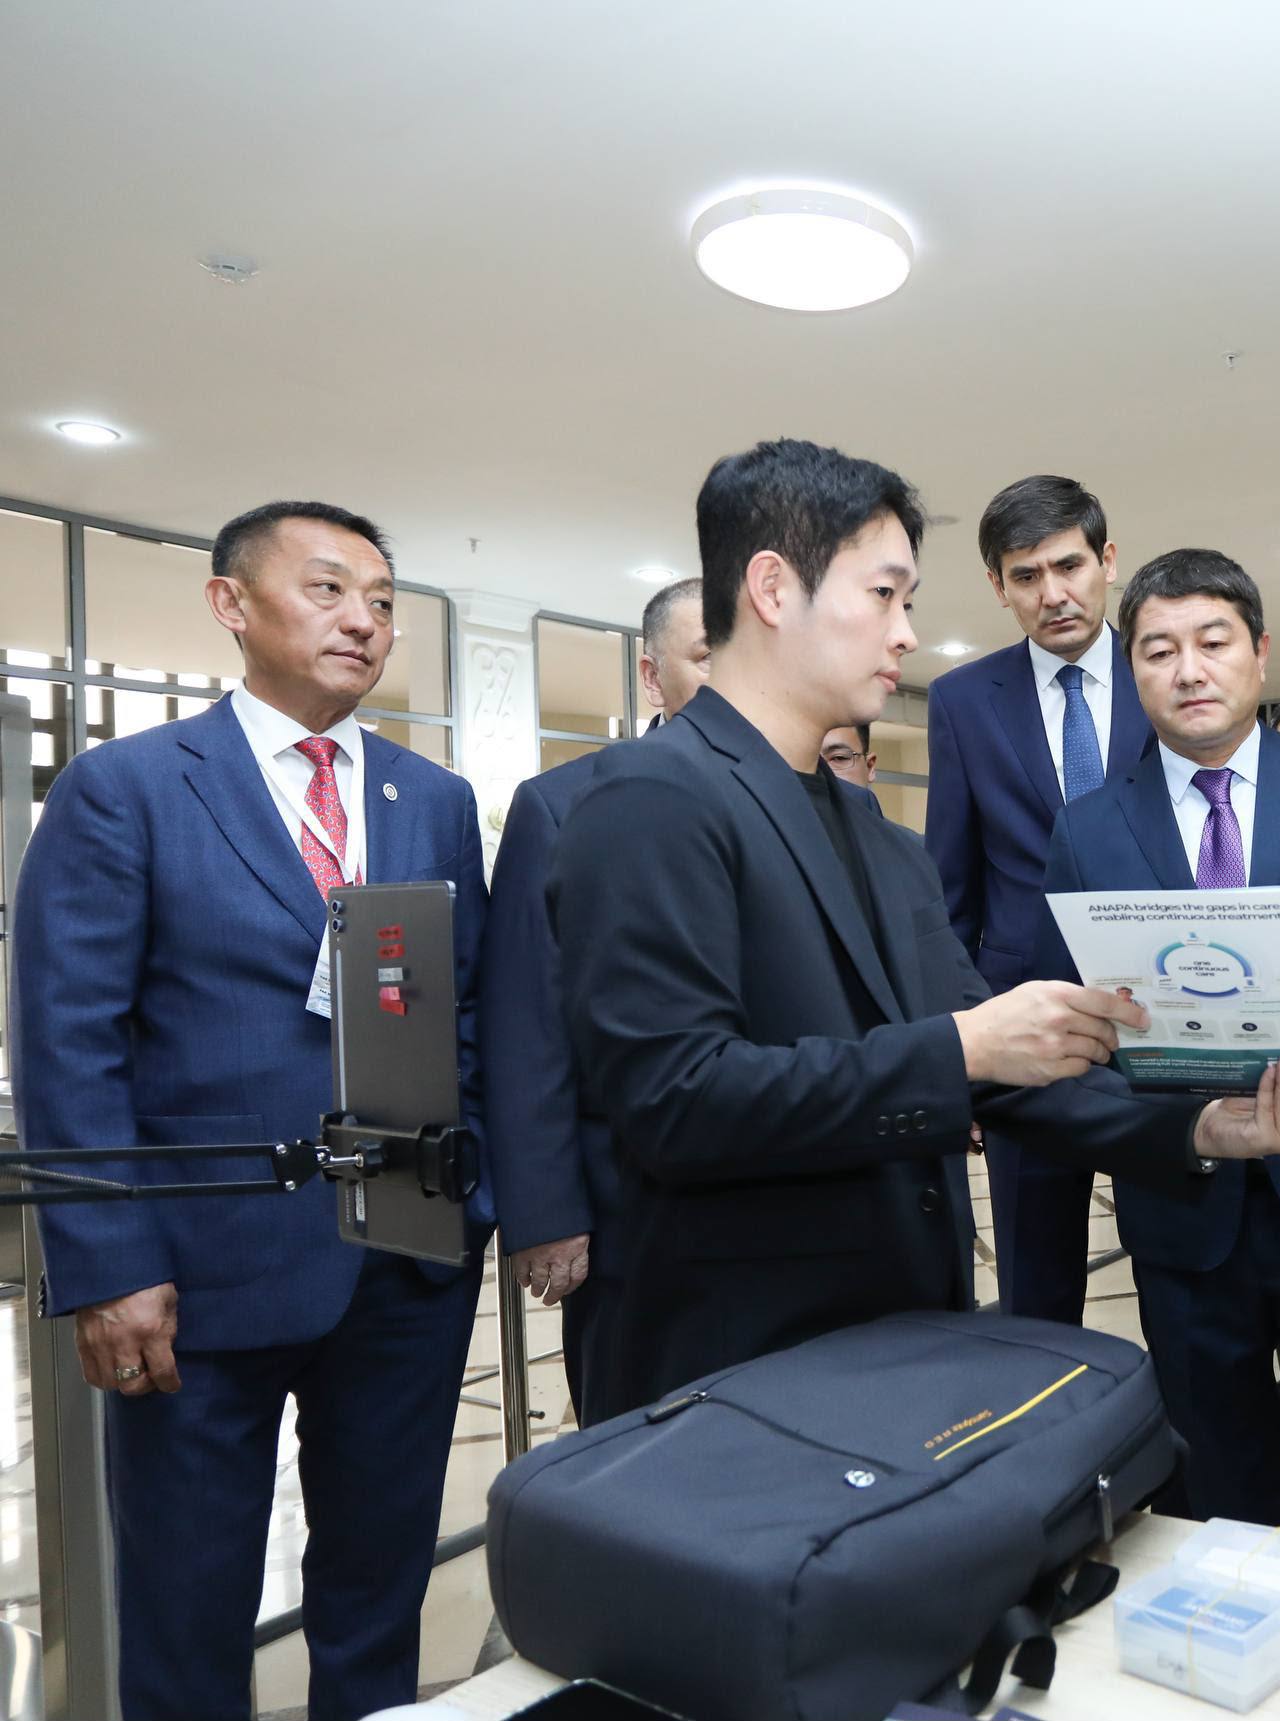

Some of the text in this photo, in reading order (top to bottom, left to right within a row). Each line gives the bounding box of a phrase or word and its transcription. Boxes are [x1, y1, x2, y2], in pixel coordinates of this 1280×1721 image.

[1088, 904, 1134, 913] ANAPA
[1134, 903, 1182, 914] bridges
[1183, 903, 1204, 911] the
[1206, 904, 1238, 914] gaps
[1238, 902, 1251, 911] in
[1091, 912, 1145, 922] enabling
[1146, 912, 1217, 921] continuous
